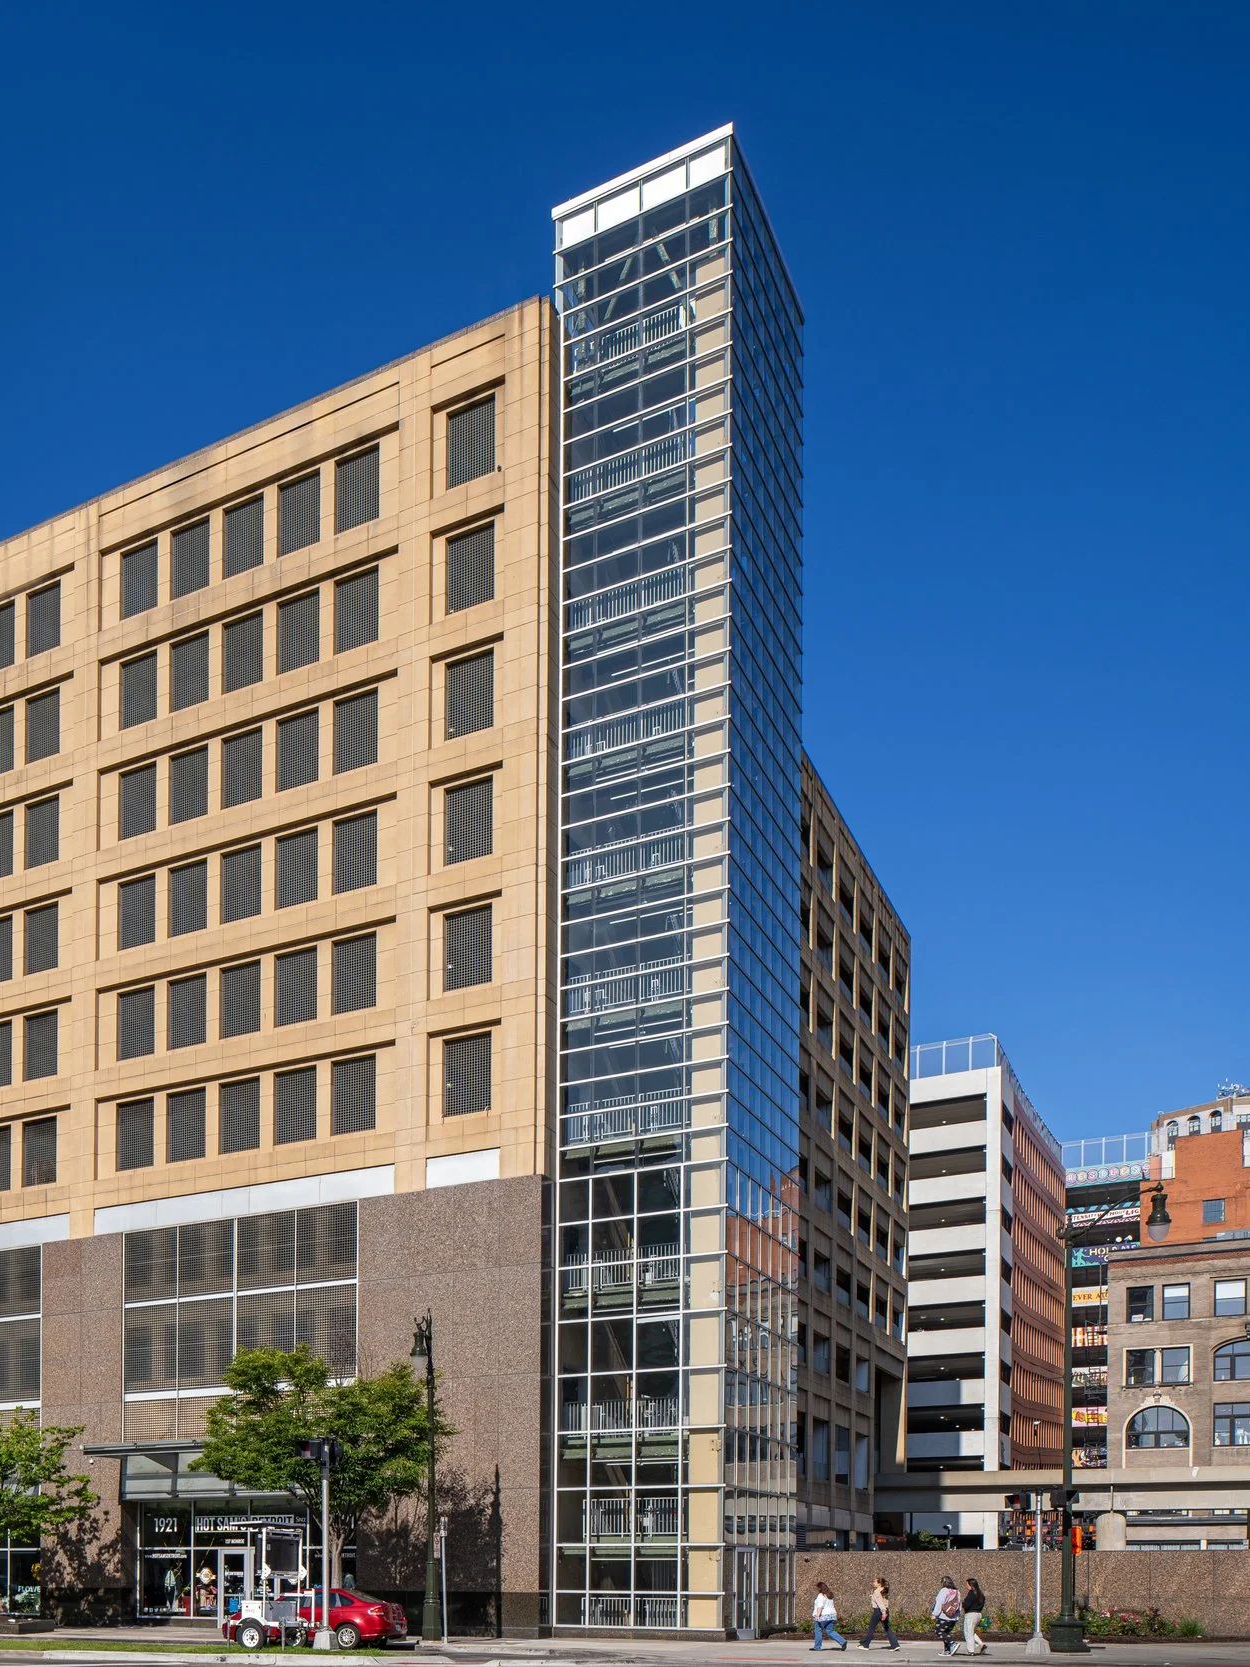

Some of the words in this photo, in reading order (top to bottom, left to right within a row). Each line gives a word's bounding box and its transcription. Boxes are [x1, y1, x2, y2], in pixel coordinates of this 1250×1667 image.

[154, 1517, 178, 1533] 1921
[196, 1517, 215, 1531] HOT
[216, 1516, 247, 1531] SAM'S
